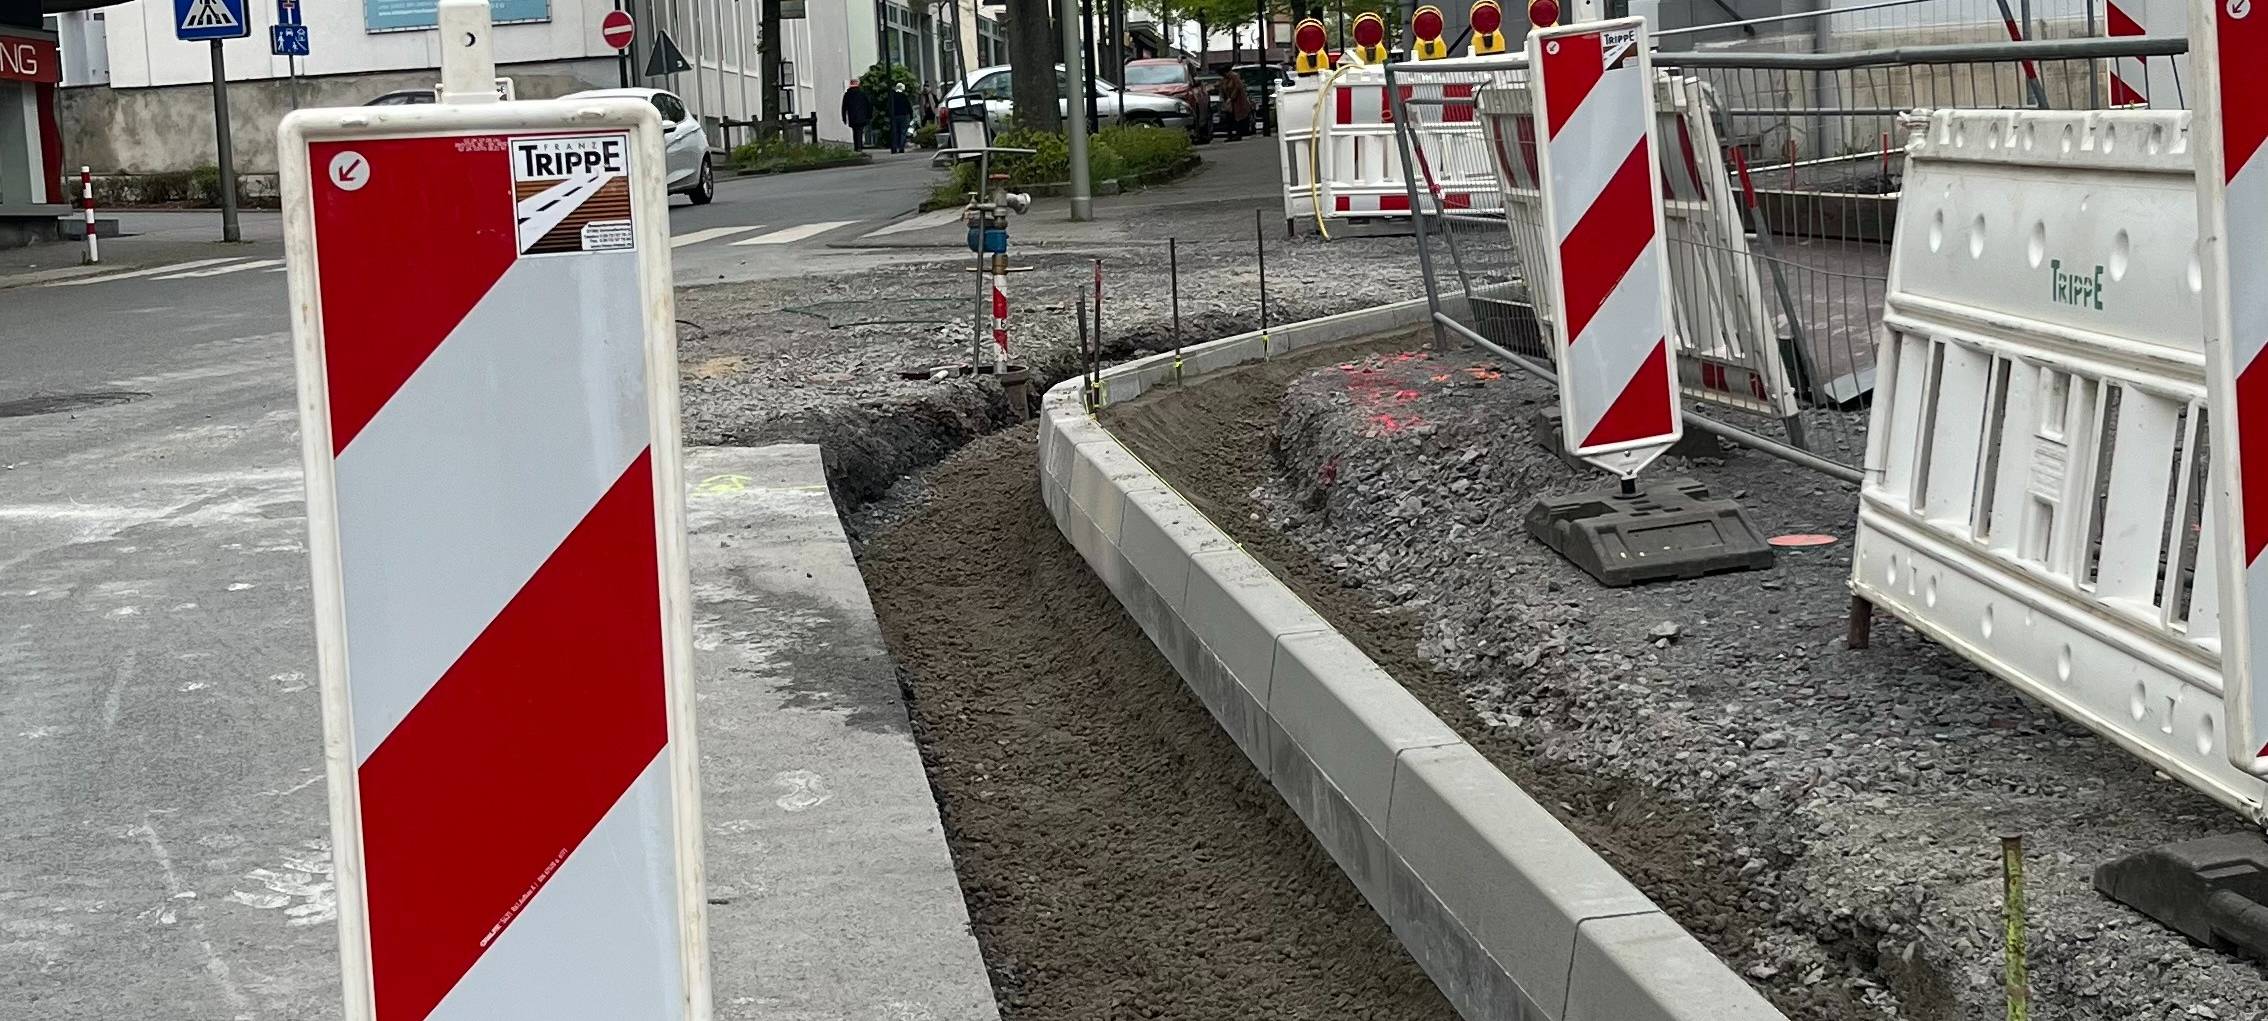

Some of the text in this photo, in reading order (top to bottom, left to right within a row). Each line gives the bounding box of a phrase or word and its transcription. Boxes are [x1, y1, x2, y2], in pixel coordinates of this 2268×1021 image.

[1603, 30, 1636, 45] TRIPPE
[518, 140, 621, 177] TRIPPE
[543, 141, 598, 151] FRANZ
[2051, 259, 2103, 310] TRIPPE
